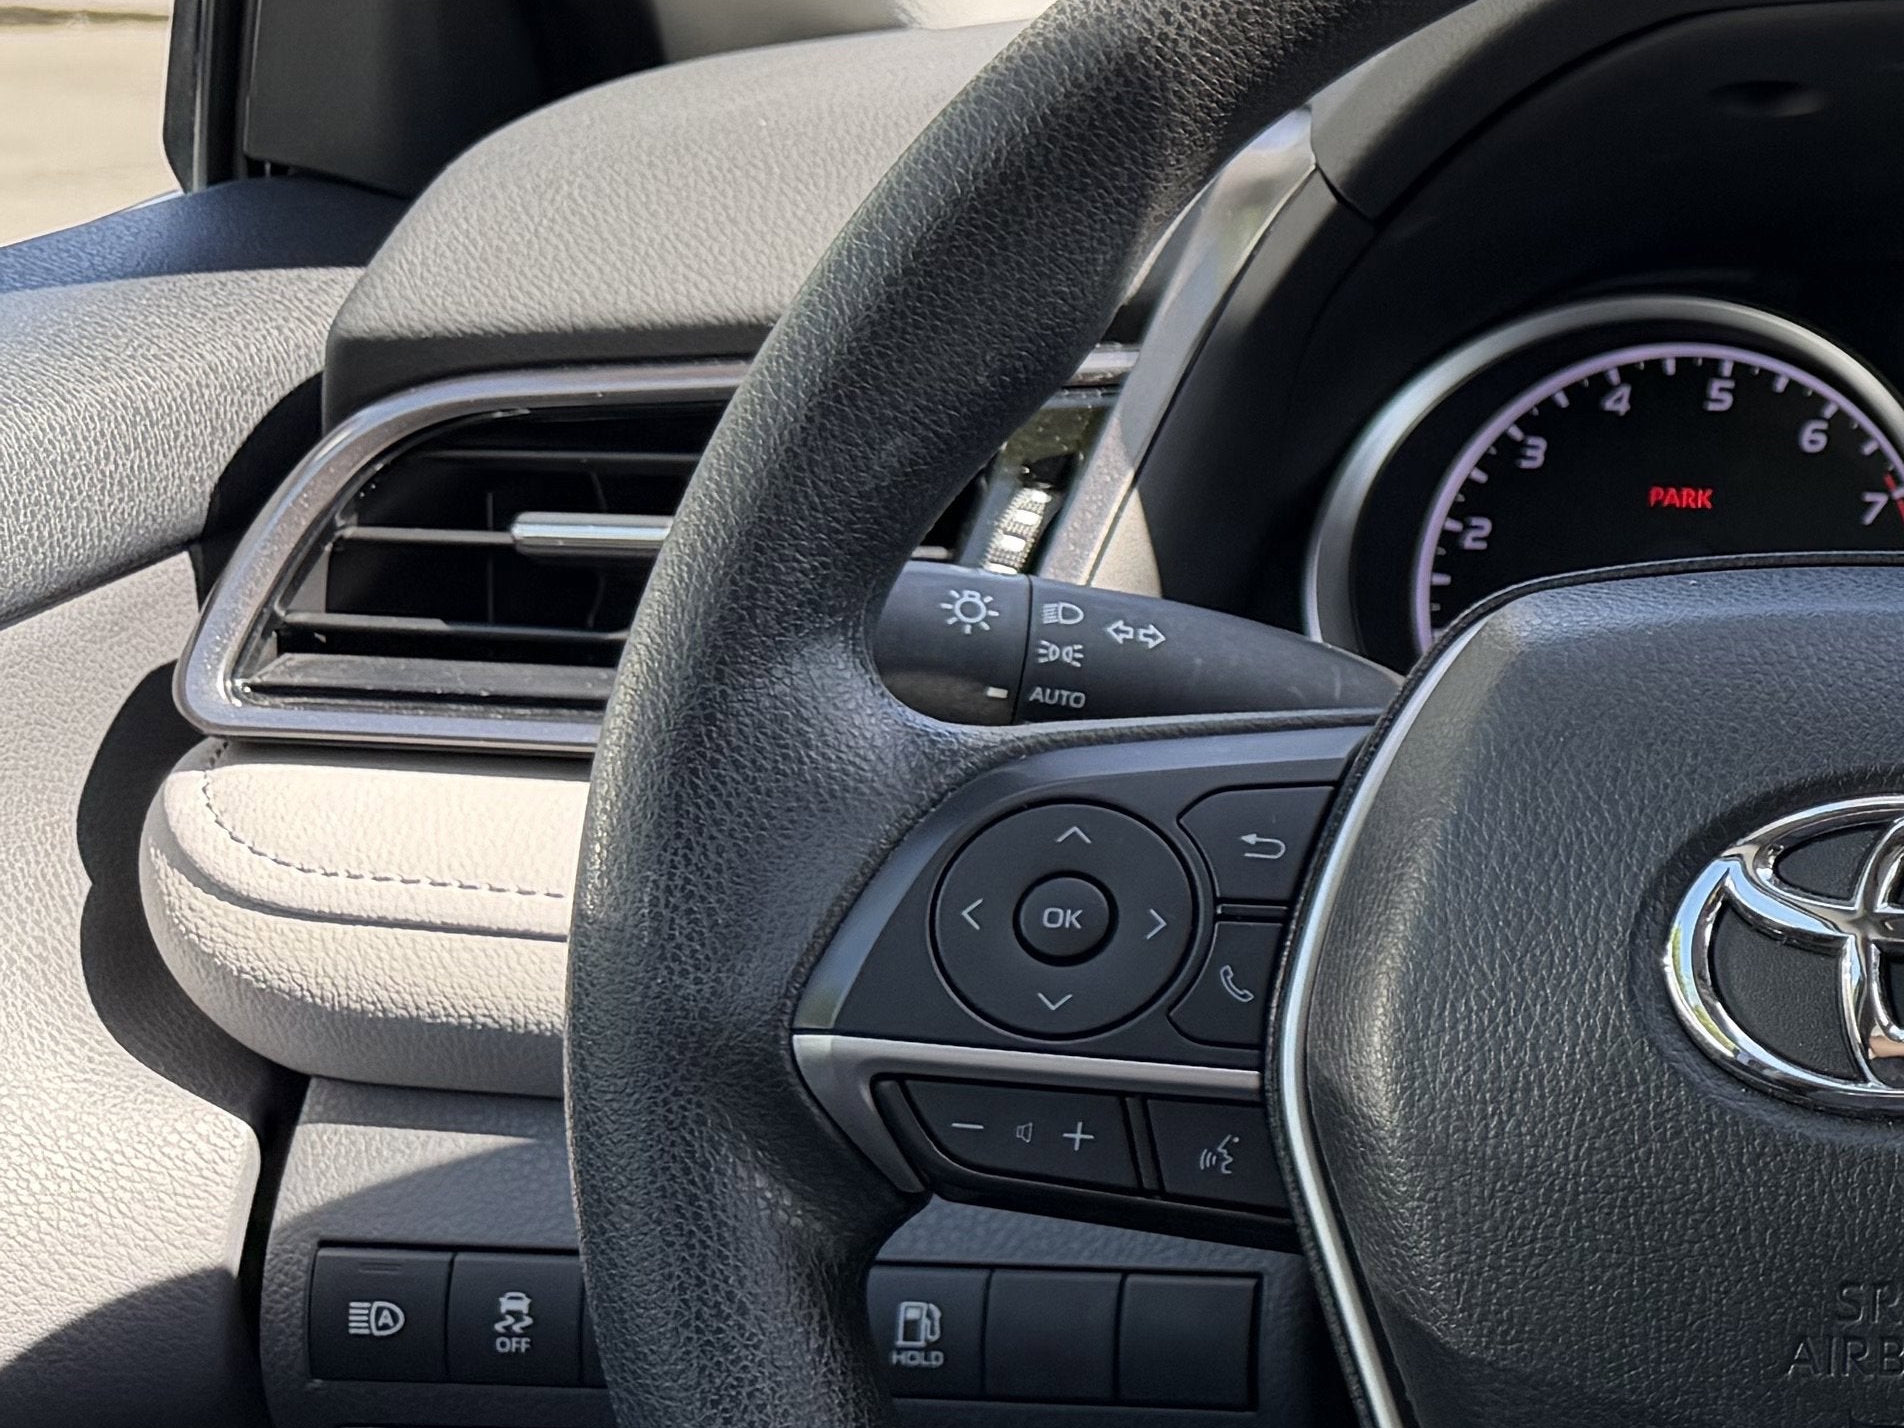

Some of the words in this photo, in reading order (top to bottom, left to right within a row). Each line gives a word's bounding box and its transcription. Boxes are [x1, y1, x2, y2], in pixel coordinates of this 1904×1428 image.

[1603, 383, 1632, 417] 4
[1704, 378, 1735, 412] 5
[1518, 436, 1548, 470] 3
[1800, 418, 1829, 454] 6
[1648, 486, 1714, 510] PARK
[1861, 489, 1890, 526] 7
[1457, 515, 1495, 552] 2
[1029, 686, 1086, 709] AUTO
[1042, 908, 1082, 930] OK
[495, 1337, 531, 1353] OFF
[892, 1350, 944, 1368] HOLD
